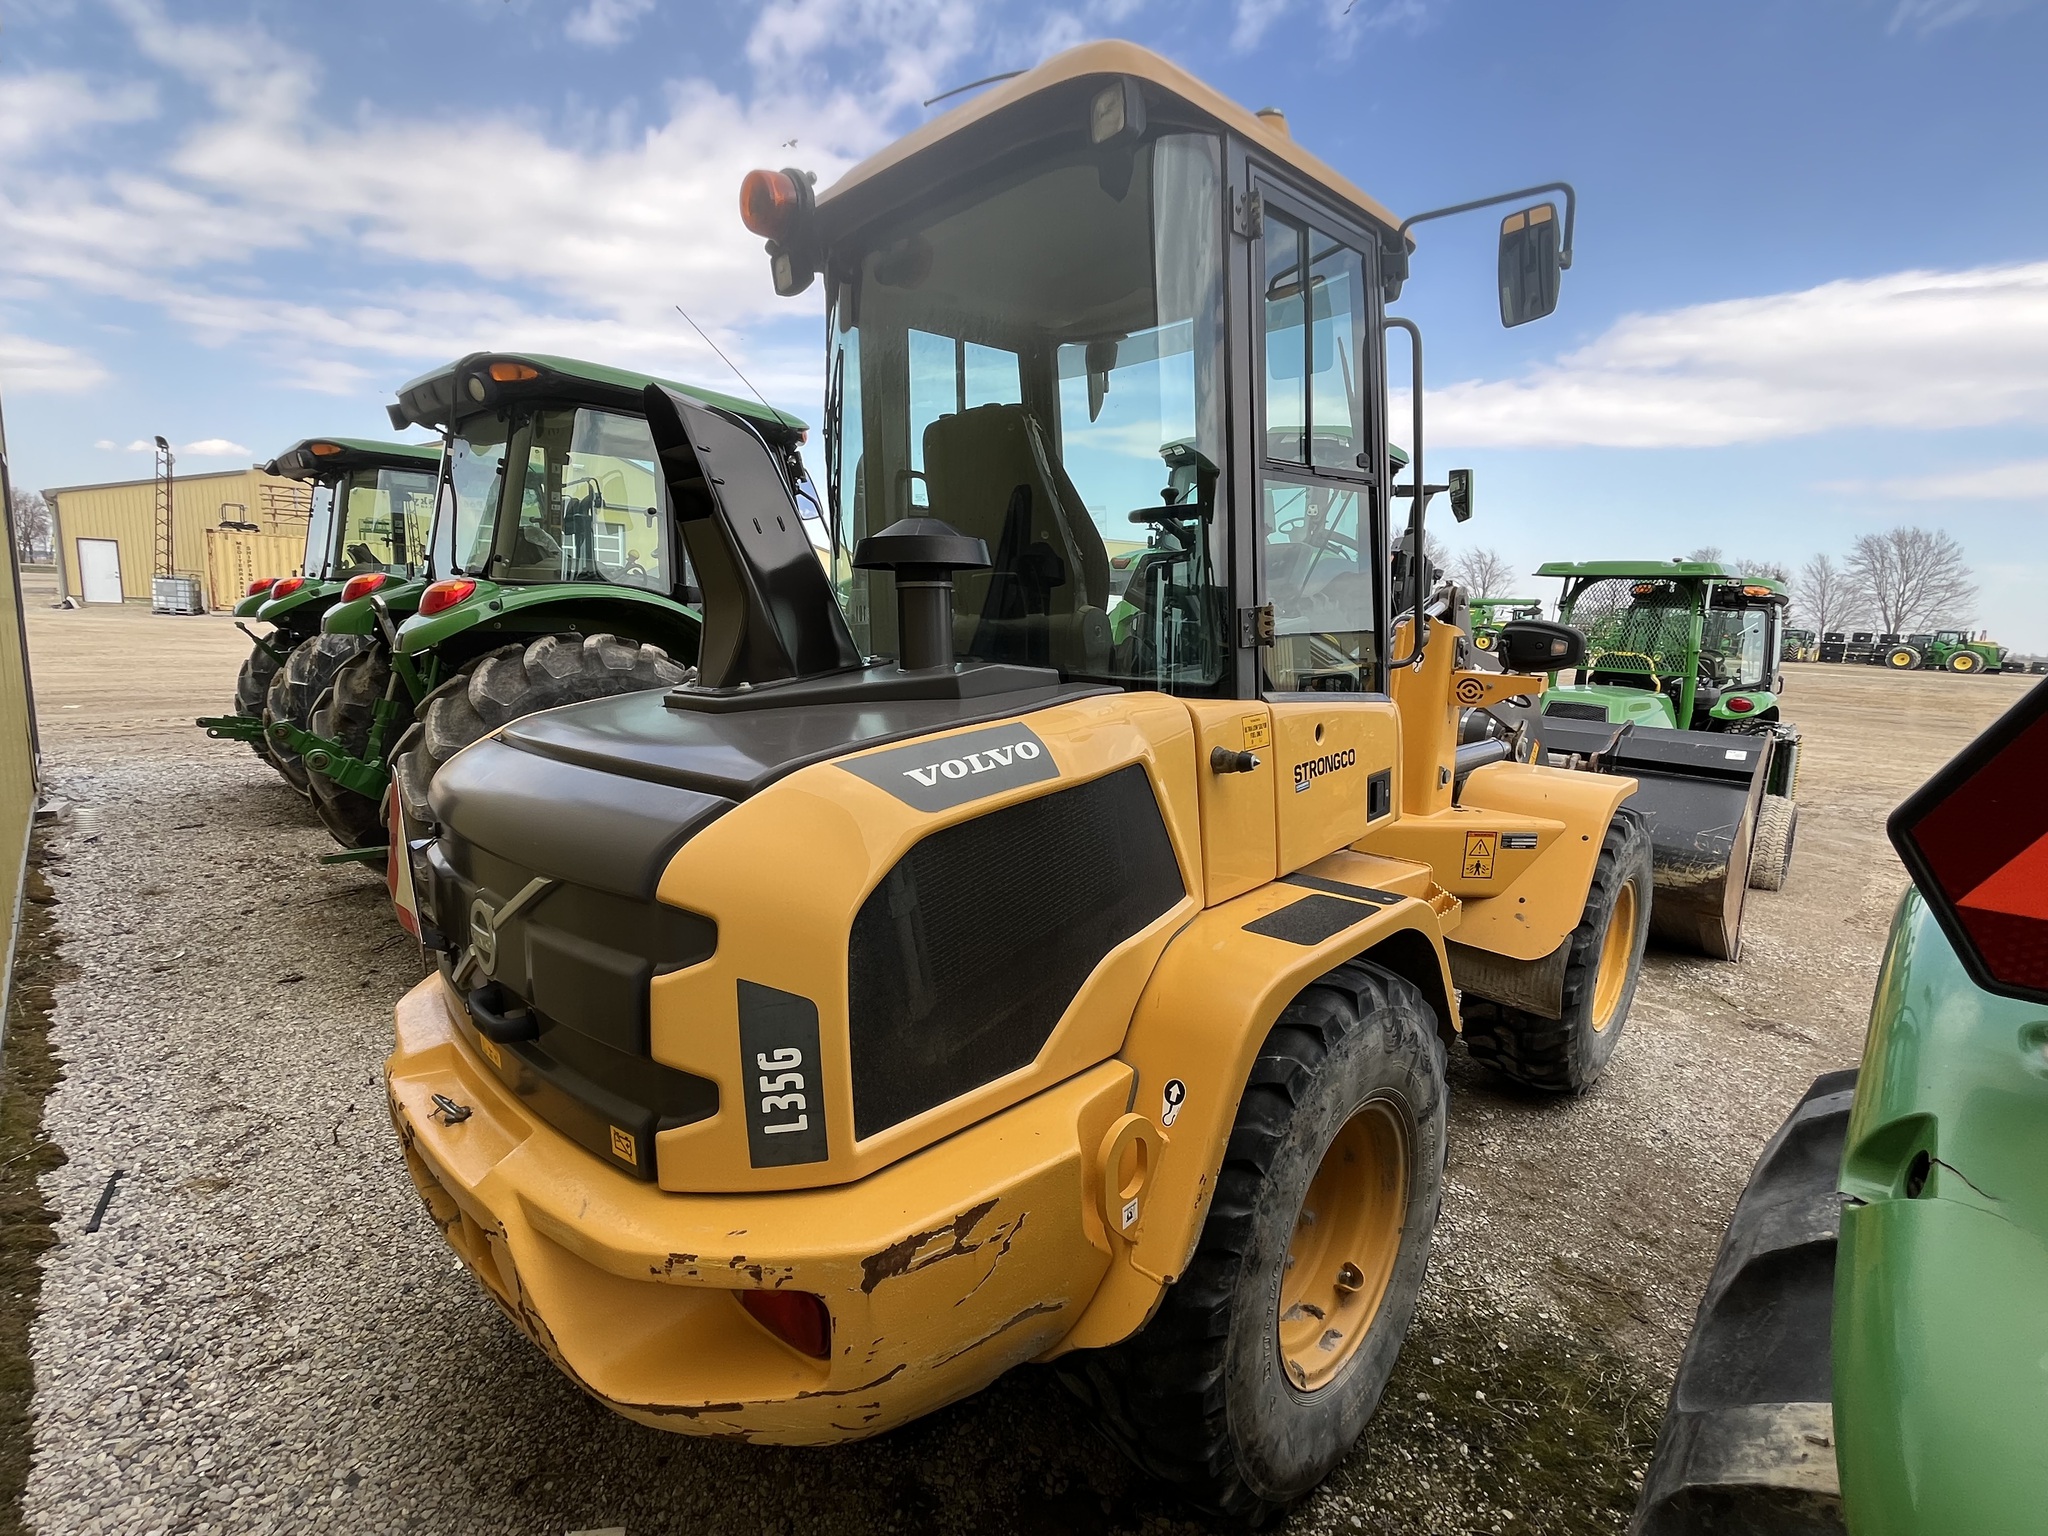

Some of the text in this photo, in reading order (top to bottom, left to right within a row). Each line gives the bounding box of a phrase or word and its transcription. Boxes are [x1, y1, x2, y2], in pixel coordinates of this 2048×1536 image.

[236, 541, 245, 598] MEDITERRANEAN
[246, 546, 254, 582] SHIPPING
[903, 741, 1040, 787] VOLVO
[1294, 748, 1355, 784] STRONGCO
[757, 1047, 808, 1134] L35G
